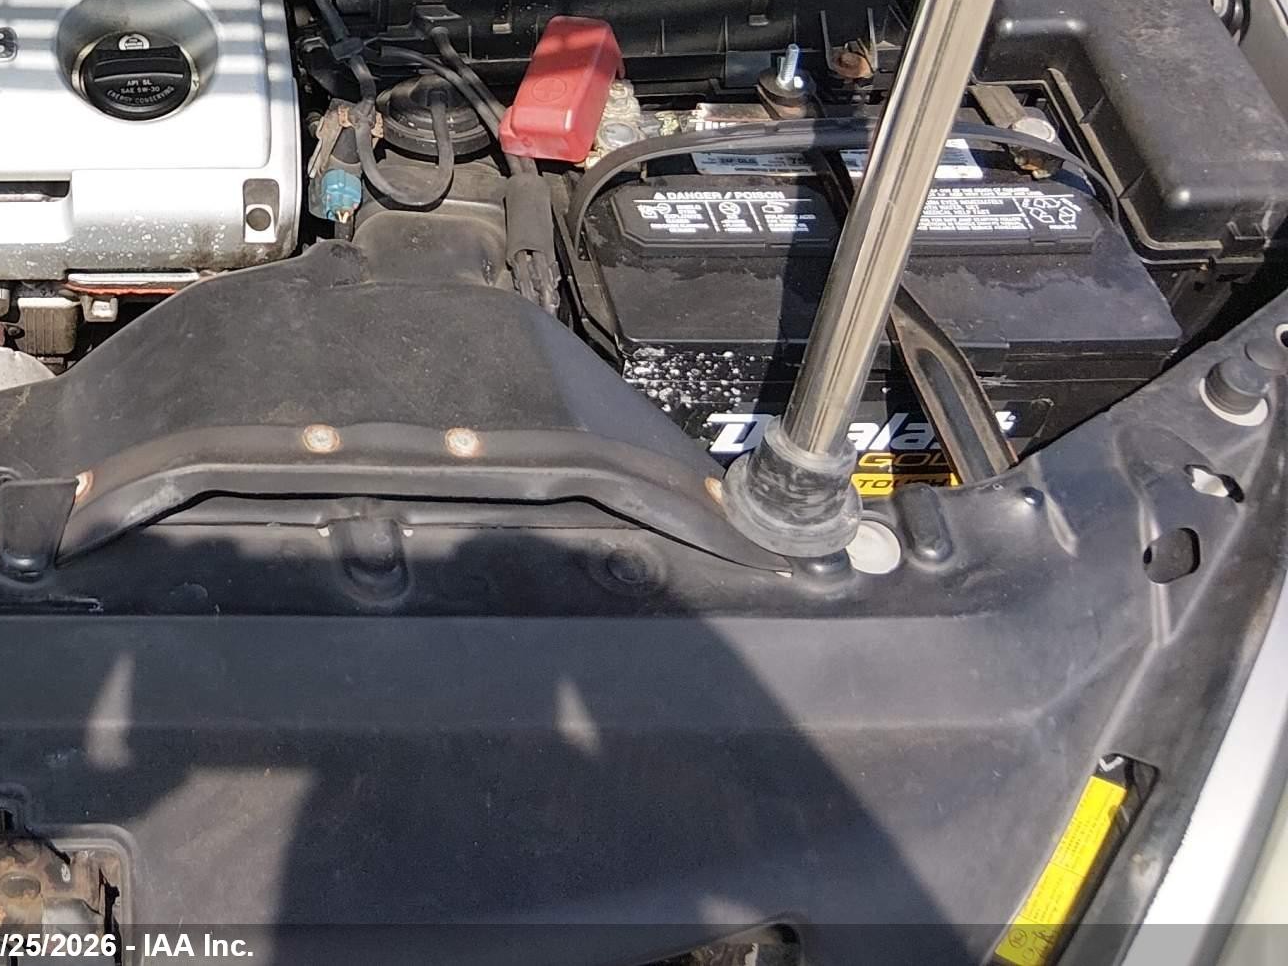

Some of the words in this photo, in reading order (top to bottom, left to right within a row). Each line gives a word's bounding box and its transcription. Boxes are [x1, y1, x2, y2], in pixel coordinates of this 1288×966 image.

[666, 191, 723, 200] DANGER
[734, 191, 786, 199] POISON
[858, 452, 949, 467] GOL
